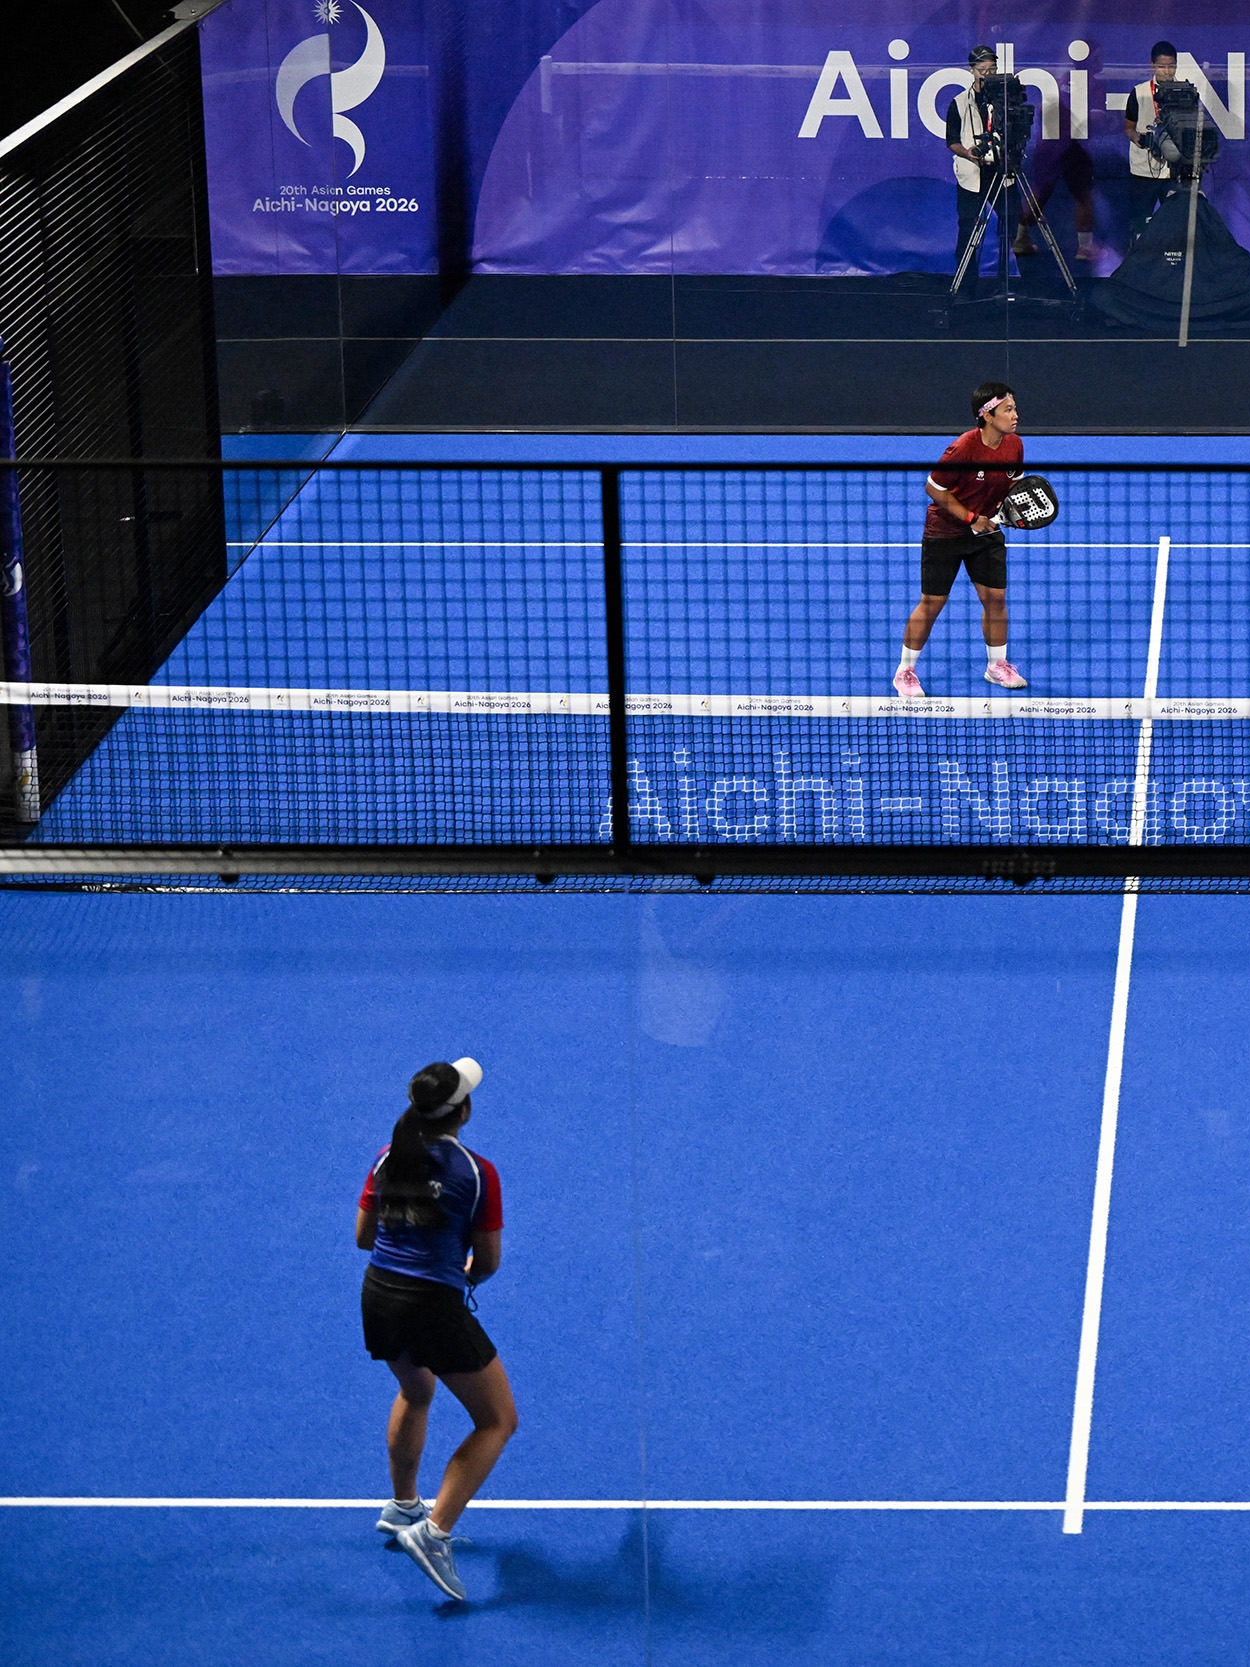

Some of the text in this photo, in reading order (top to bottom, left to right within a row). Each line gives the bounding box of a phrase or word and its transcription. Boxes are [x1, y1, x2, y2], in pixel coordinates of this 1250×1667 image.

[280, 185, 391, 195] 20th Asian Games
[252, 197, 419, 216] Aichi-Nagoya 2026
[31, 692, 85, 700] Aichi-Nagoya
[172, 695, 227, 704] Aichi-Nagoya
[313, 698, 368, 707] Aichi-Nagoya
[454, 700, 509, 709] Aichi-Nagoya
[596, 702, 650, 711] Aicagoya
[737, 704, 792, 712] Aichi-Nagoya
[878, 705, 933, 713] Aichi-Nagoya
[1019, 706, 1074, 715] Aichi-Nagoya
[1161, 706, 1215, 715] Aichi-Nagoya
